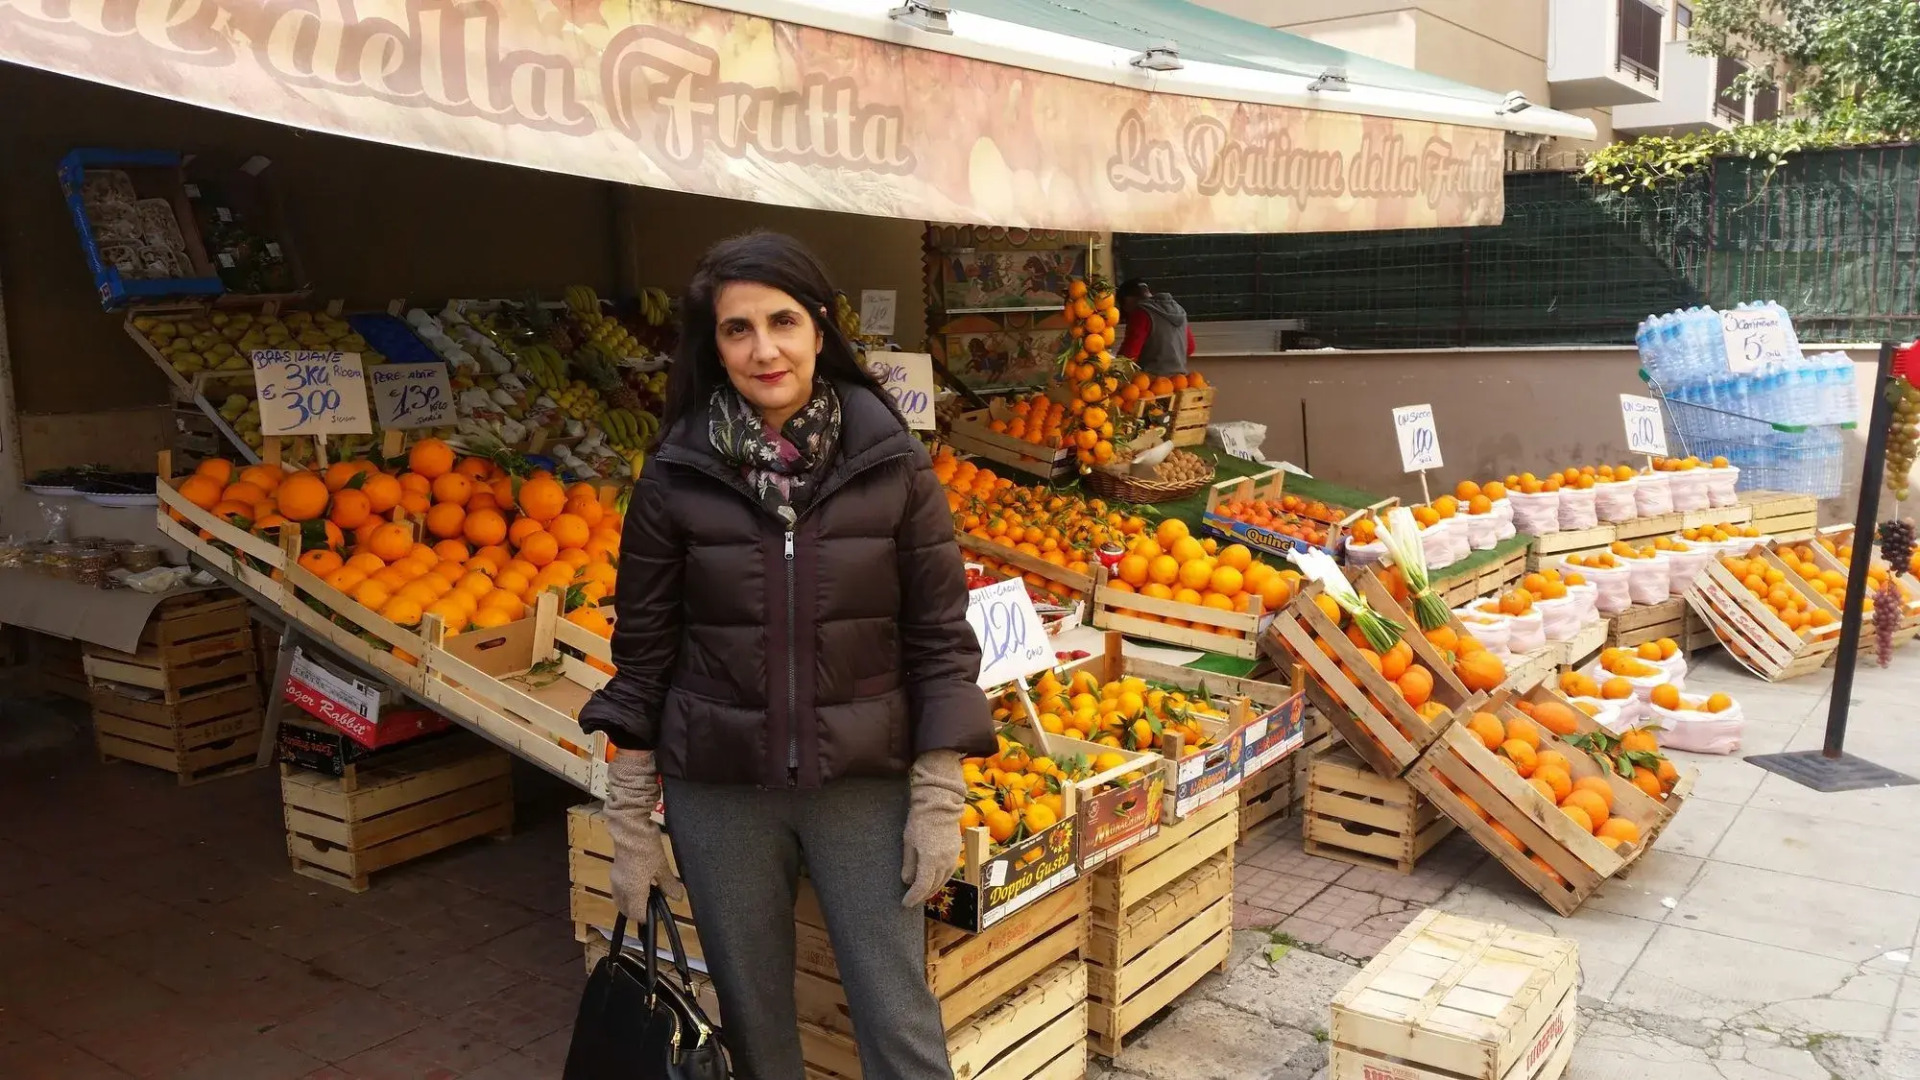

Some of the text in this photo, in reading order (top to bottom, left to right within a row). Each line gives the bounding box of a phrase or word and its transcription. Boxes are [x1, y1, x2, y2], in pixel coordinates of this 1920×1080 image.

[266, 0, 586, 126] della
[609, 34, 912, 168] Frutta
[1108, 115, 1500, 207] La Boutique della Frutta
[318, 698, 367, 736] Rabbit
[989, 852, 1070, 906] Doppio Gusto
